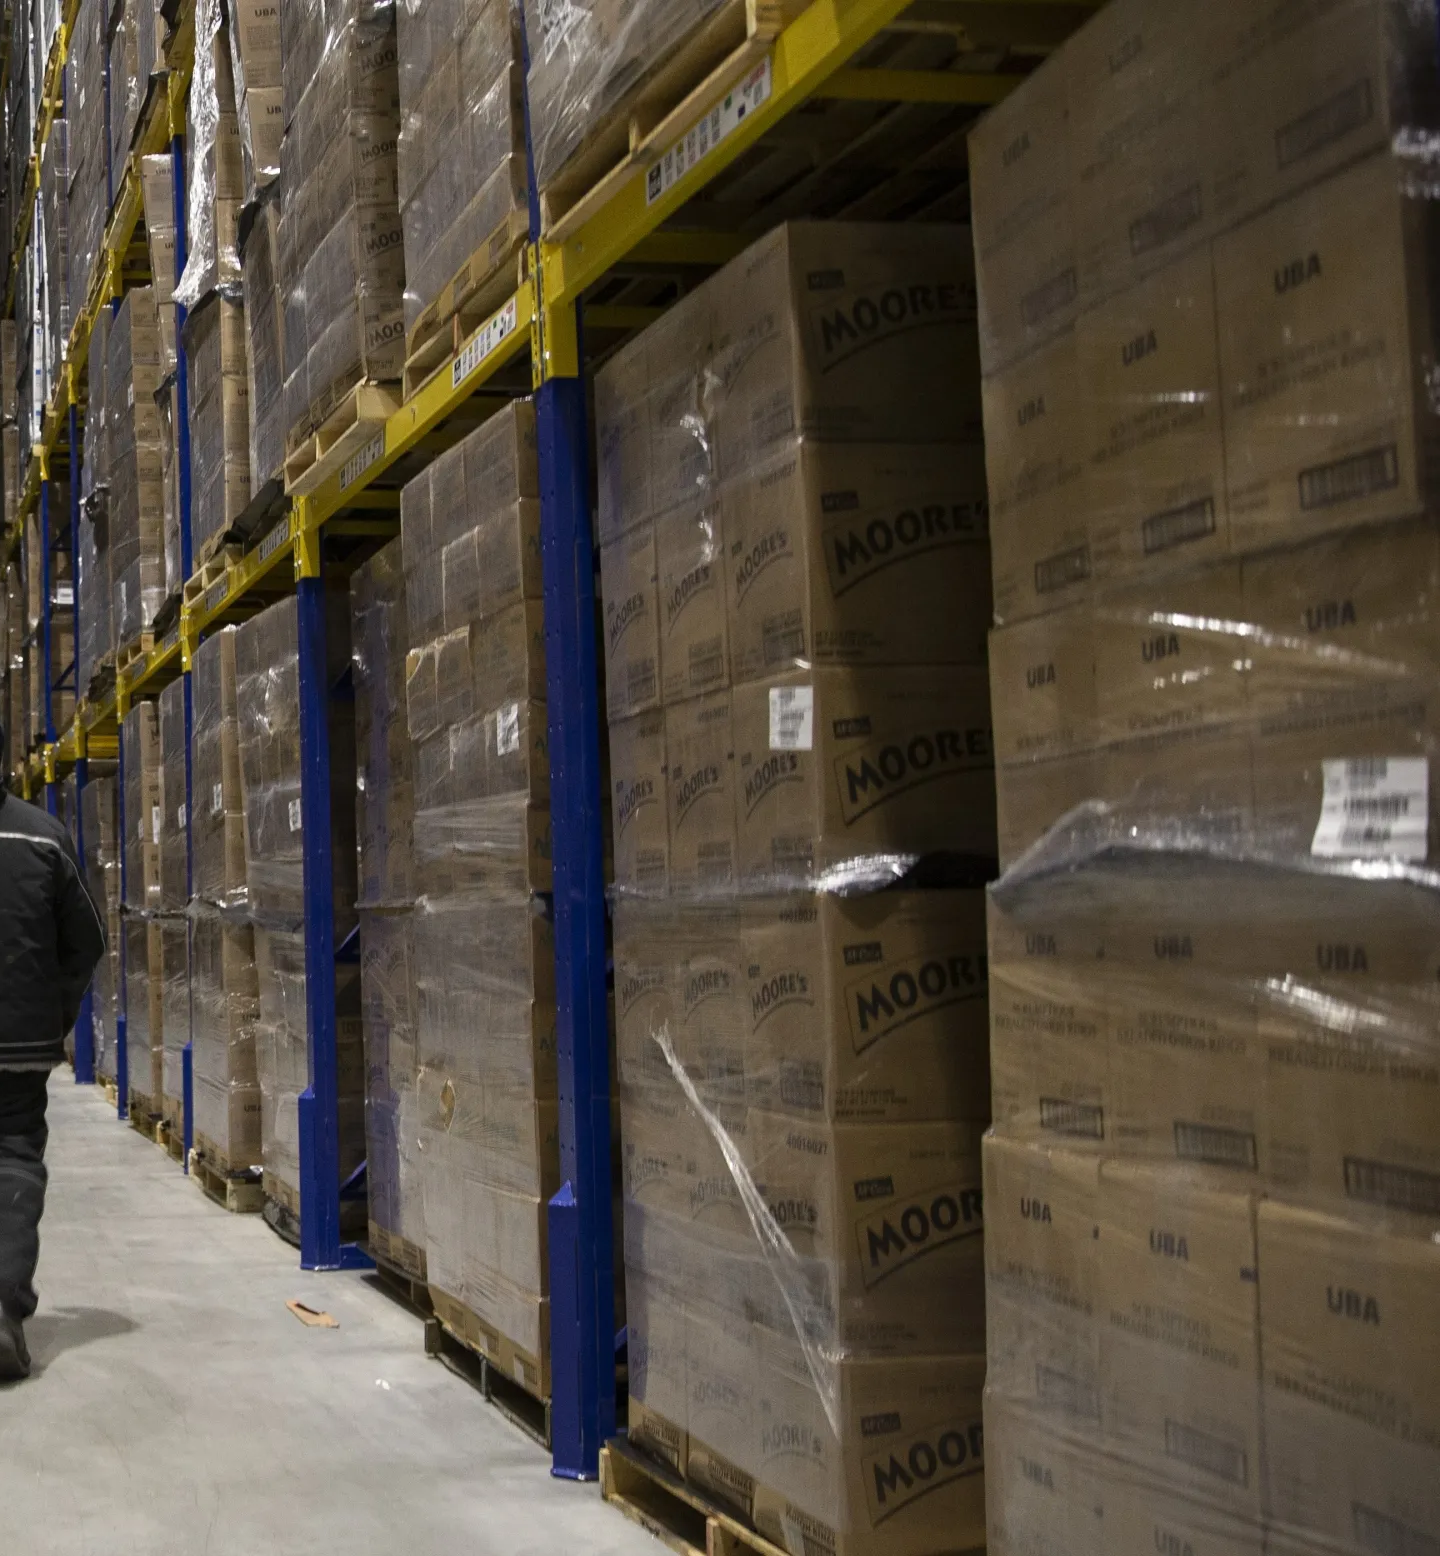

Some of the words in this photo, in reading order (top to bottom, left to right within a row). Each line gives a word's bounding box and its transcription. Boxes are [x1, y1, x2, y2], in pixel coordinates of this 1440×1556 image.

[255, 8, 277, 17] UBA
[1002, 131, 1031, 167] UBA
[1273, 251, 1322, 295] UBA
[1121, 328, 1158, 367] UBA
[1017, 396, 1046, 427] UBA
[736, 531, 787, 593] MOORE'S
[1306, 599, 1358, 634] UBA
[1141, 632, 1180, 664] UBA
[1026, 662, 1056, 689] UBA
[676, 765, 719, 808] MOORE'S
[745, 752, 797, 806] MOORE'S
[618, 780, 653, 827] MOORE'S
[1025, 933, 1057, 957] UBA
[1153, 933, 1194, 961] UBA
[1315, 940, 1369, 975] UBA
[752, 972, 807, 1019] MOORE'S
[1020, 1196, 1052, 1225] UBA
[1148, 1227, 1190, 1262] UBA
[1326, 1283, 1381, 1327] UBA
[1018, 1456, 1055, 1492] UBA
